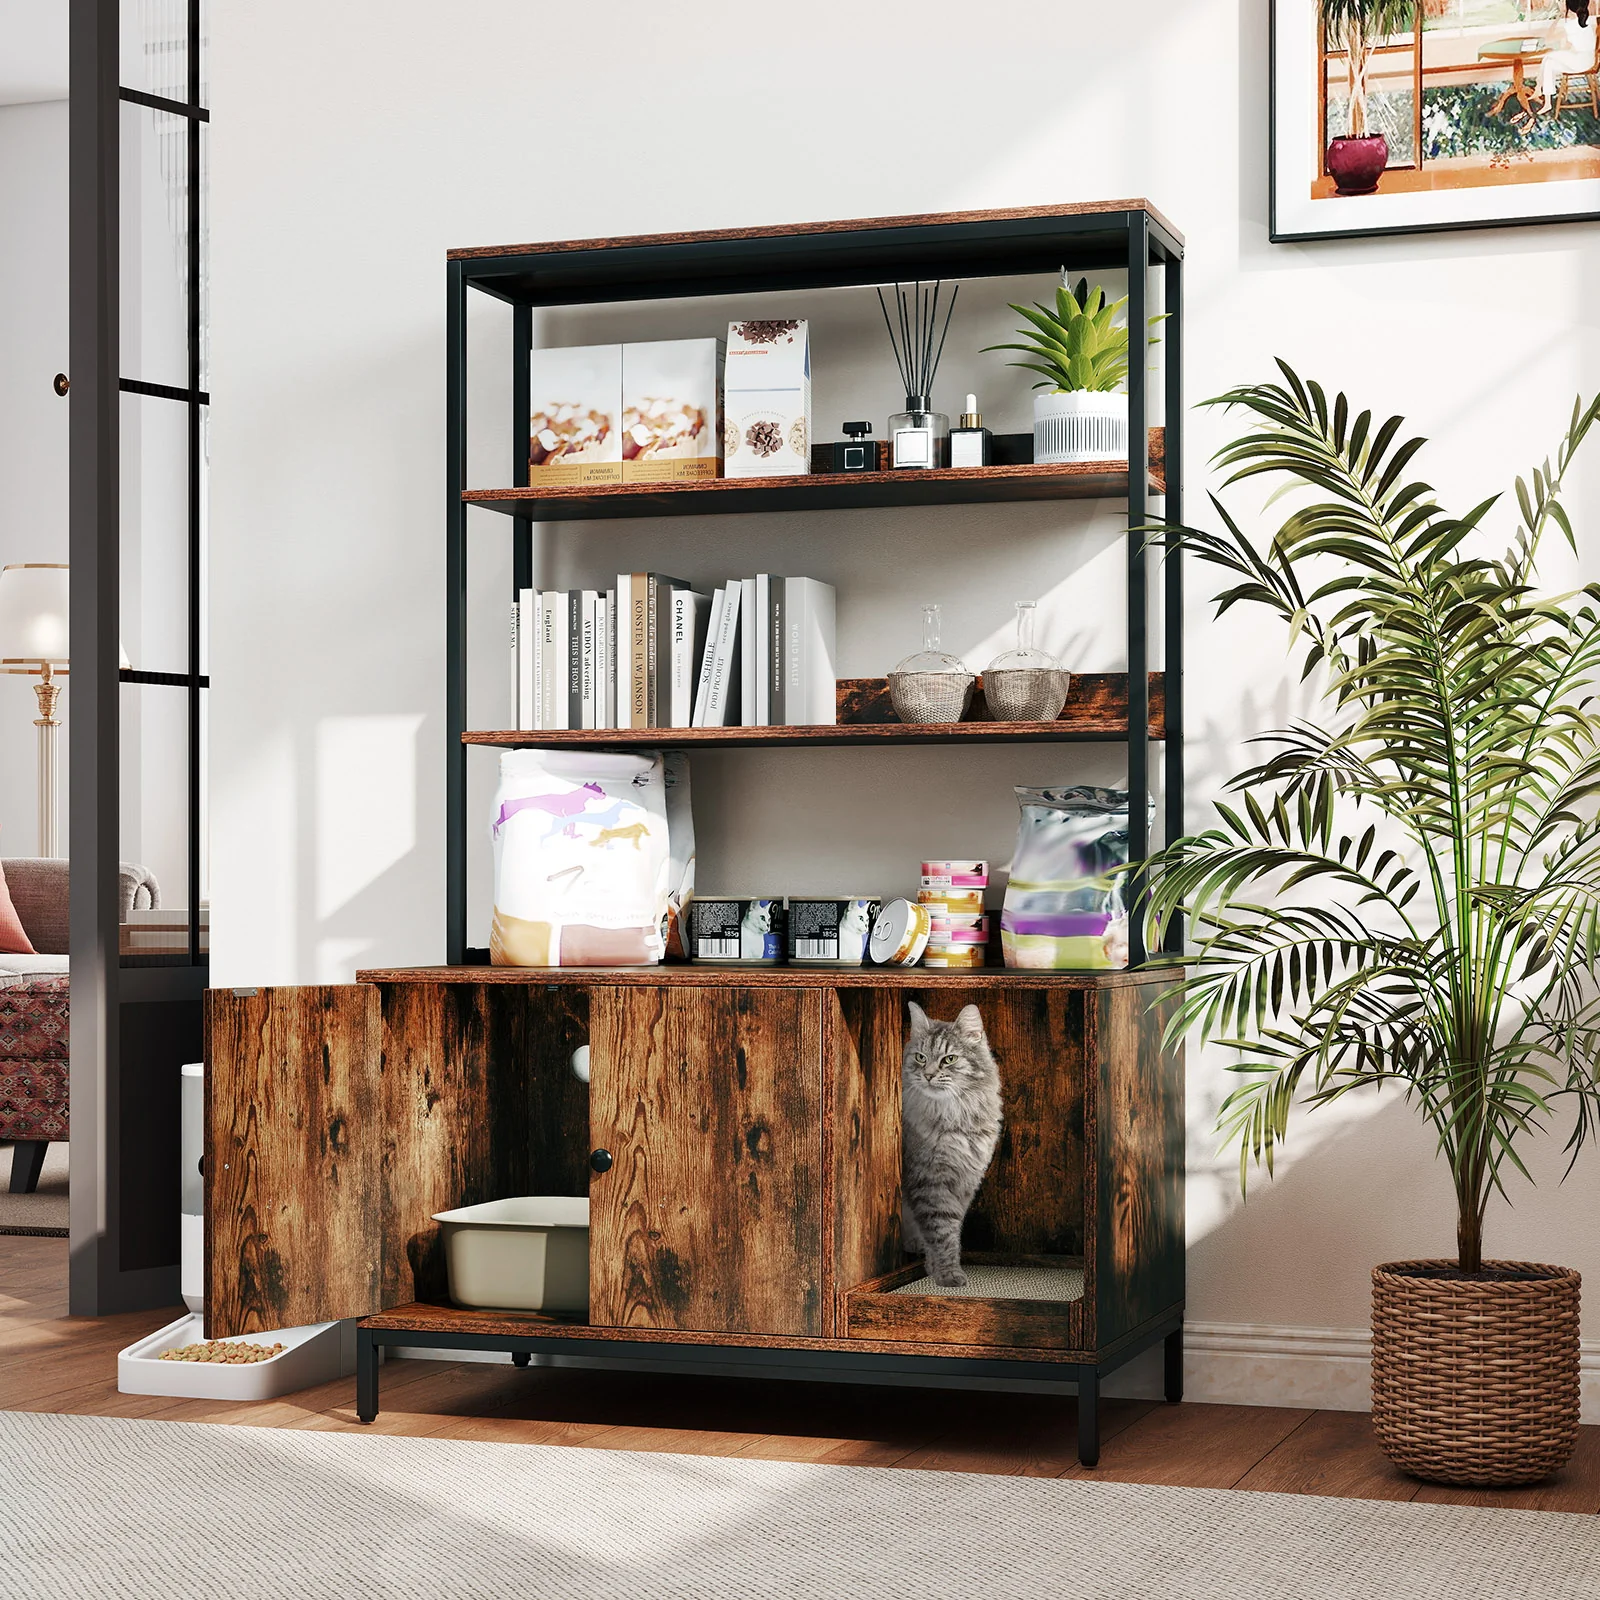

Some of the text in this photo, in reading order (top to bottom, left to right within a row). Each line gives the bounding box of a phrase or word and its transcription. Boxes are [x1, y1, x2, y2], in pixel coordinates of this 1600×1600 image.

[544, 609, 553, 643] England
[675, 599, 684, 644] CHANEL
[571, 636, 579, 656] THIS
[571, 657, 579, 665] IS
[583, 618, 592, 700] AVEDON advertising
[634, 599, 643, 715] KONSTEN H.W.JANSON
[702, 642, 716, 684] SCHIELE
[791, 624, 800, 687] WORLD BALLET
[571, 667, 579, 694] HOME
[710, 690, 719, 710] JODI
